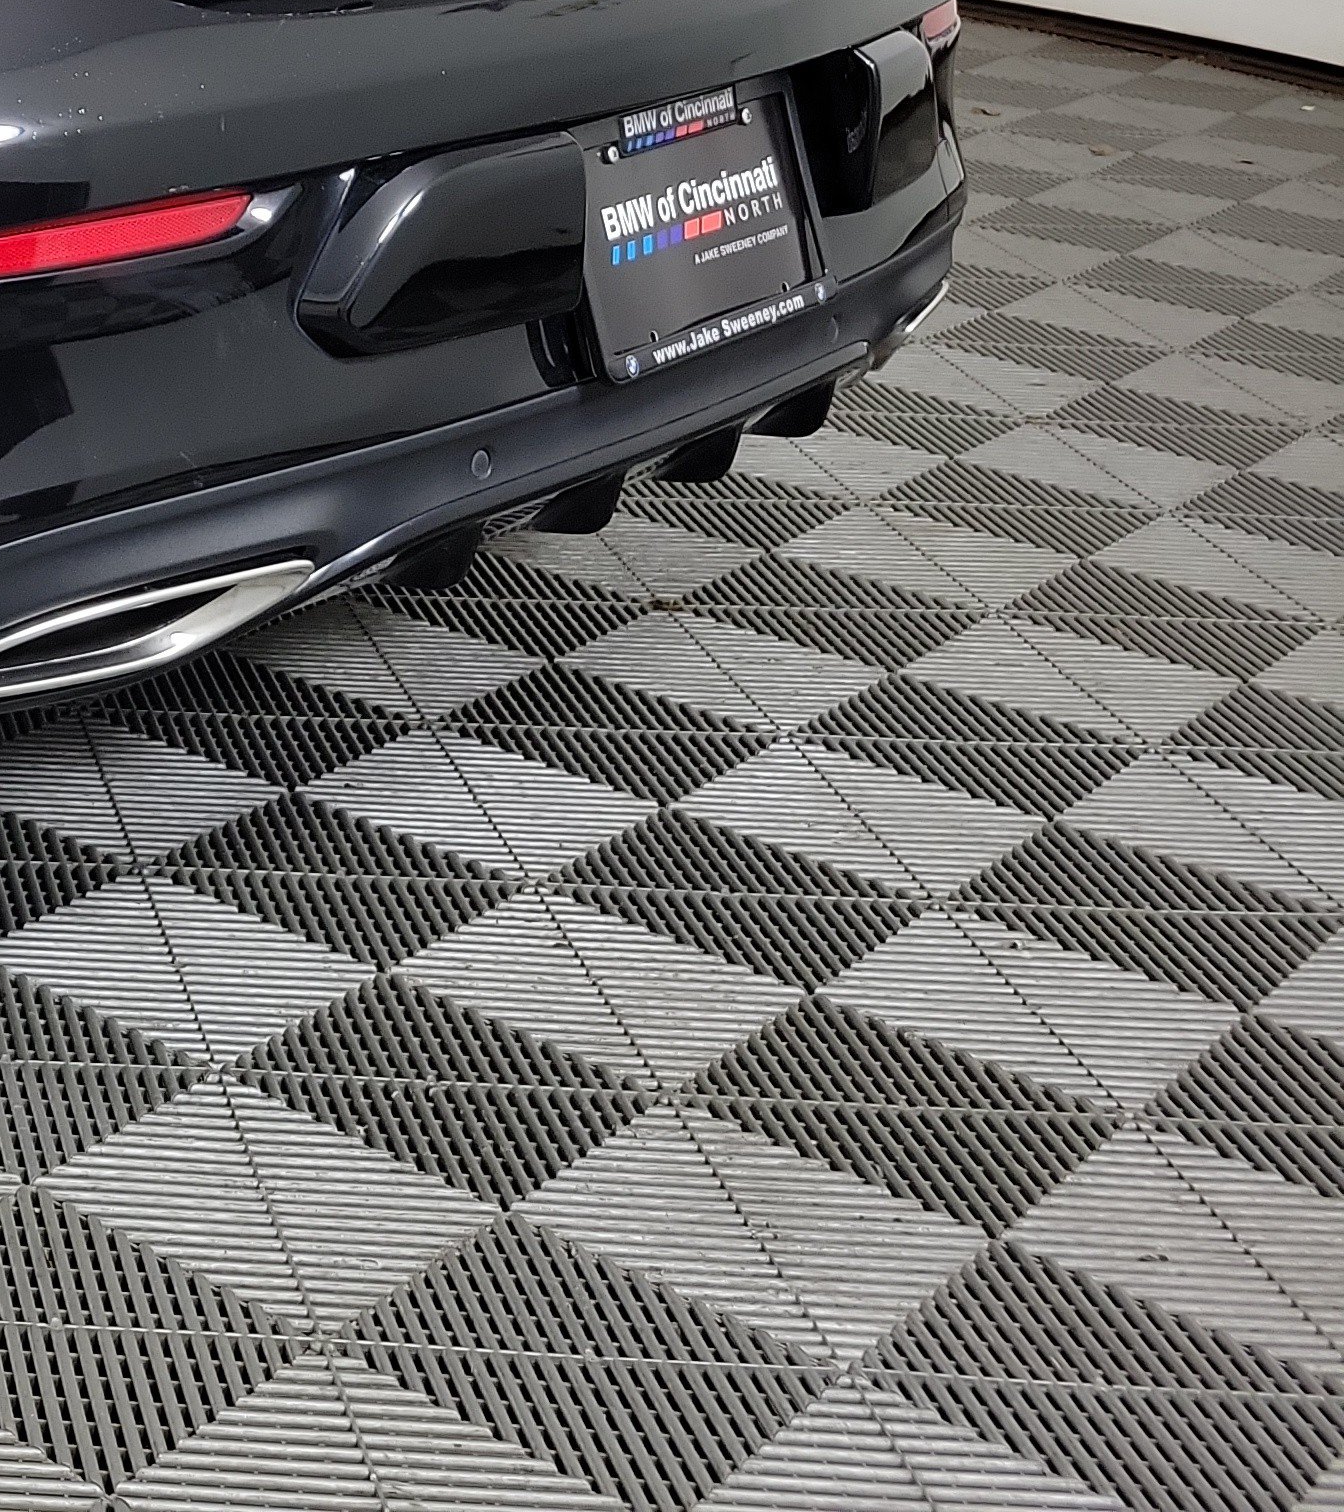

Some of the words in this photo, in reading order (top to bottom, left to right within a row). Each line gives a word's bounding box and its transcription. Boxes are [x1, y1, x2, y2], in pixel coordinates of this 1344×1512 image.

[622, 108, 658, 138] BMW
[659, 105, 673, 127] of
[673, 86, 734, 123] Cincinnati
[601, 194, 655, 241] BMW
[657, 186, 677, 223] of
[677, 156, 779, 215] Cincinnati
[723, 191, 784, 227] NORTH
[694, 252, 702, 265] A
[700, 245, 721, 263] JAKE
[720, 234, 758, 257] SWEENEY
[757, 223, 790, 245] COMPANY
[652, 326, 721, 365] www.Jake
[720, 294, 805, 338] Sweeney.com
